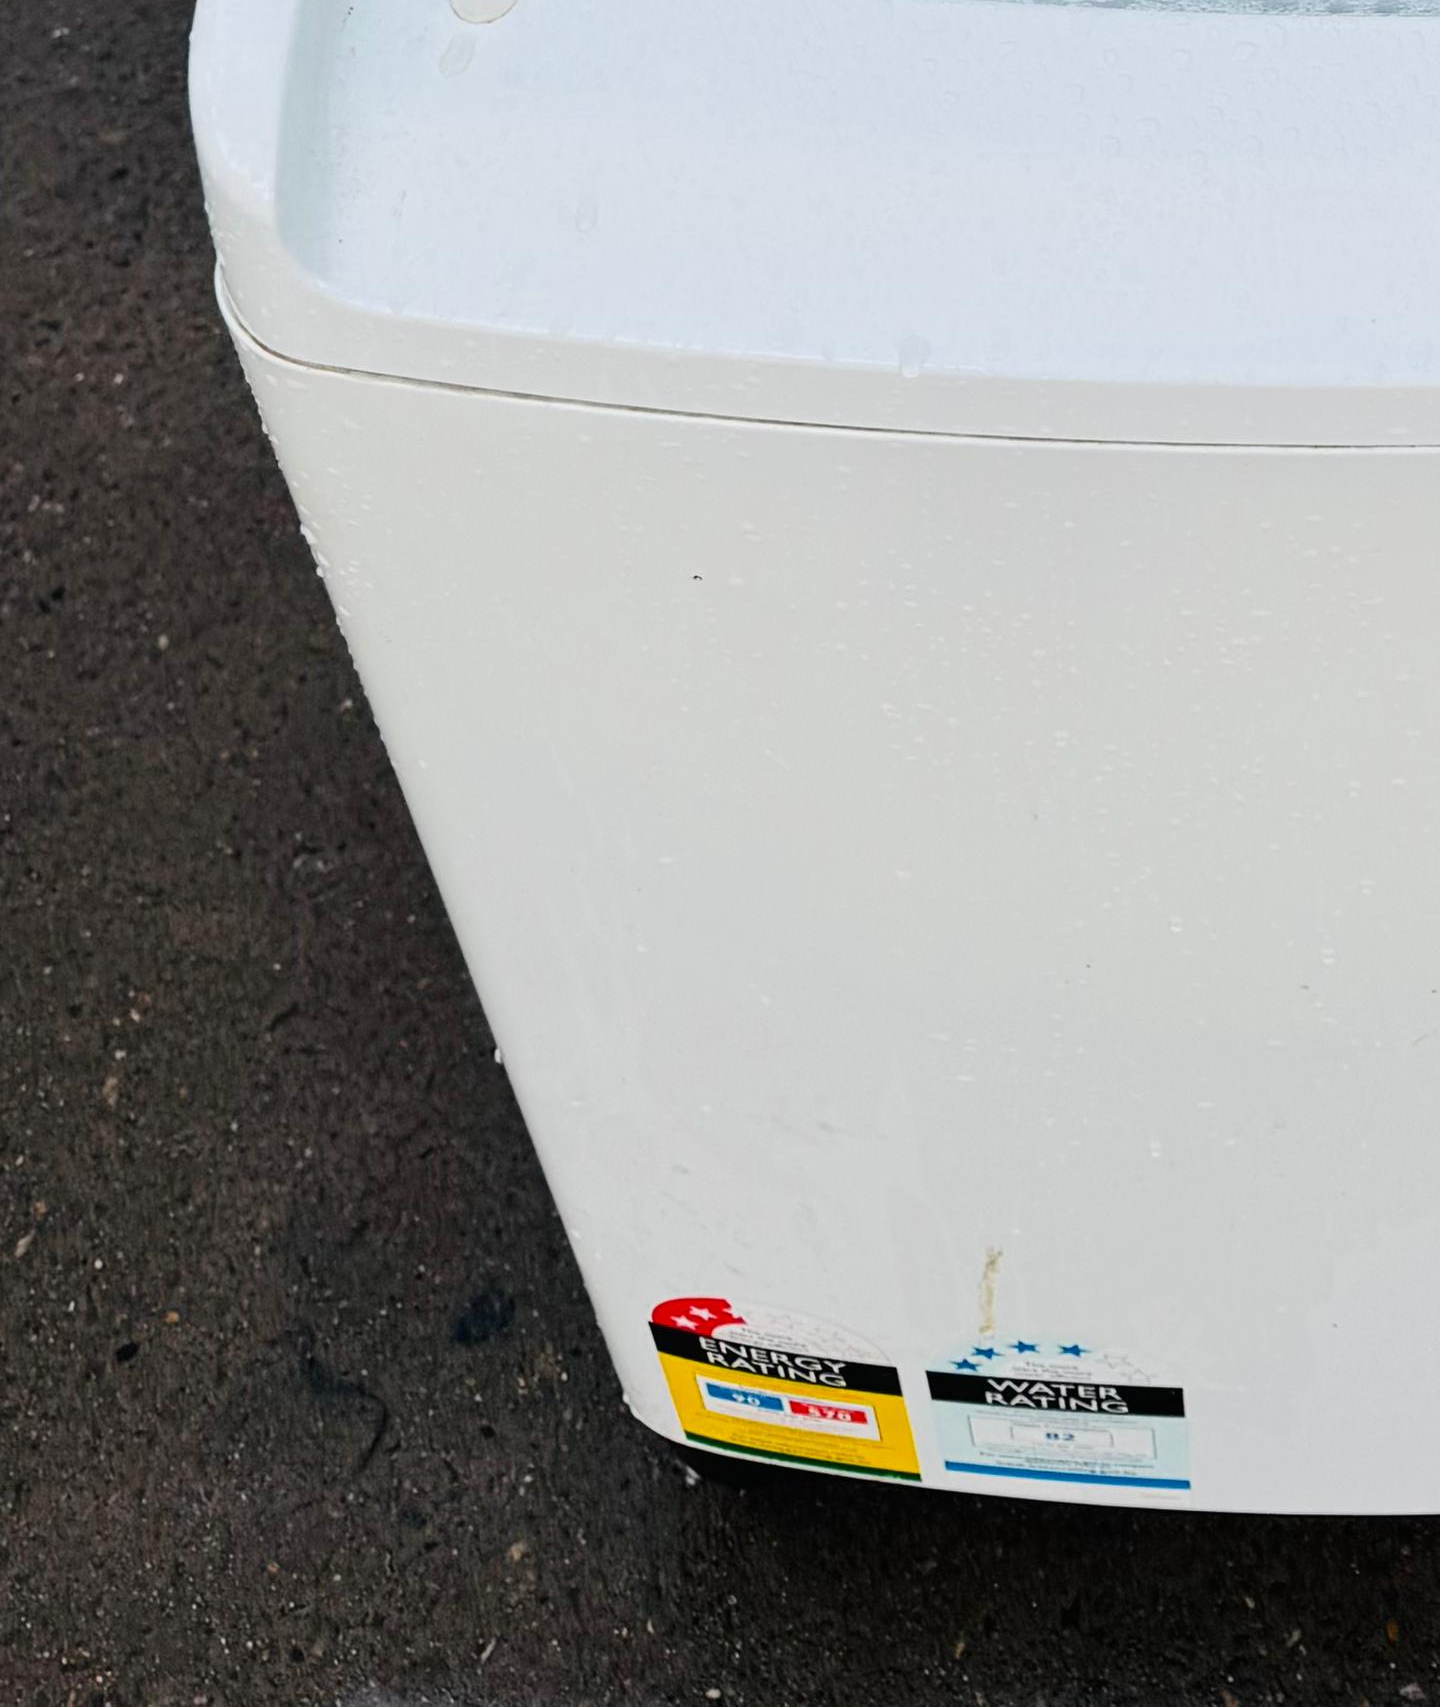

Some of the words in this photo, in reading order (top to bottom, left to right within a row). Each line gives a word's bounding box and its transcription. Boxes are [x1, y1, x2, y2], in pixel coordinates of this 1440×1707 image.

[699, 1337, 847, 1374] ENERGY
[706, 1351, 848, 1388] RATING
[984, 1390, 1129, 1414] RATING
[986, 1378, 1123, 1400] WATER
